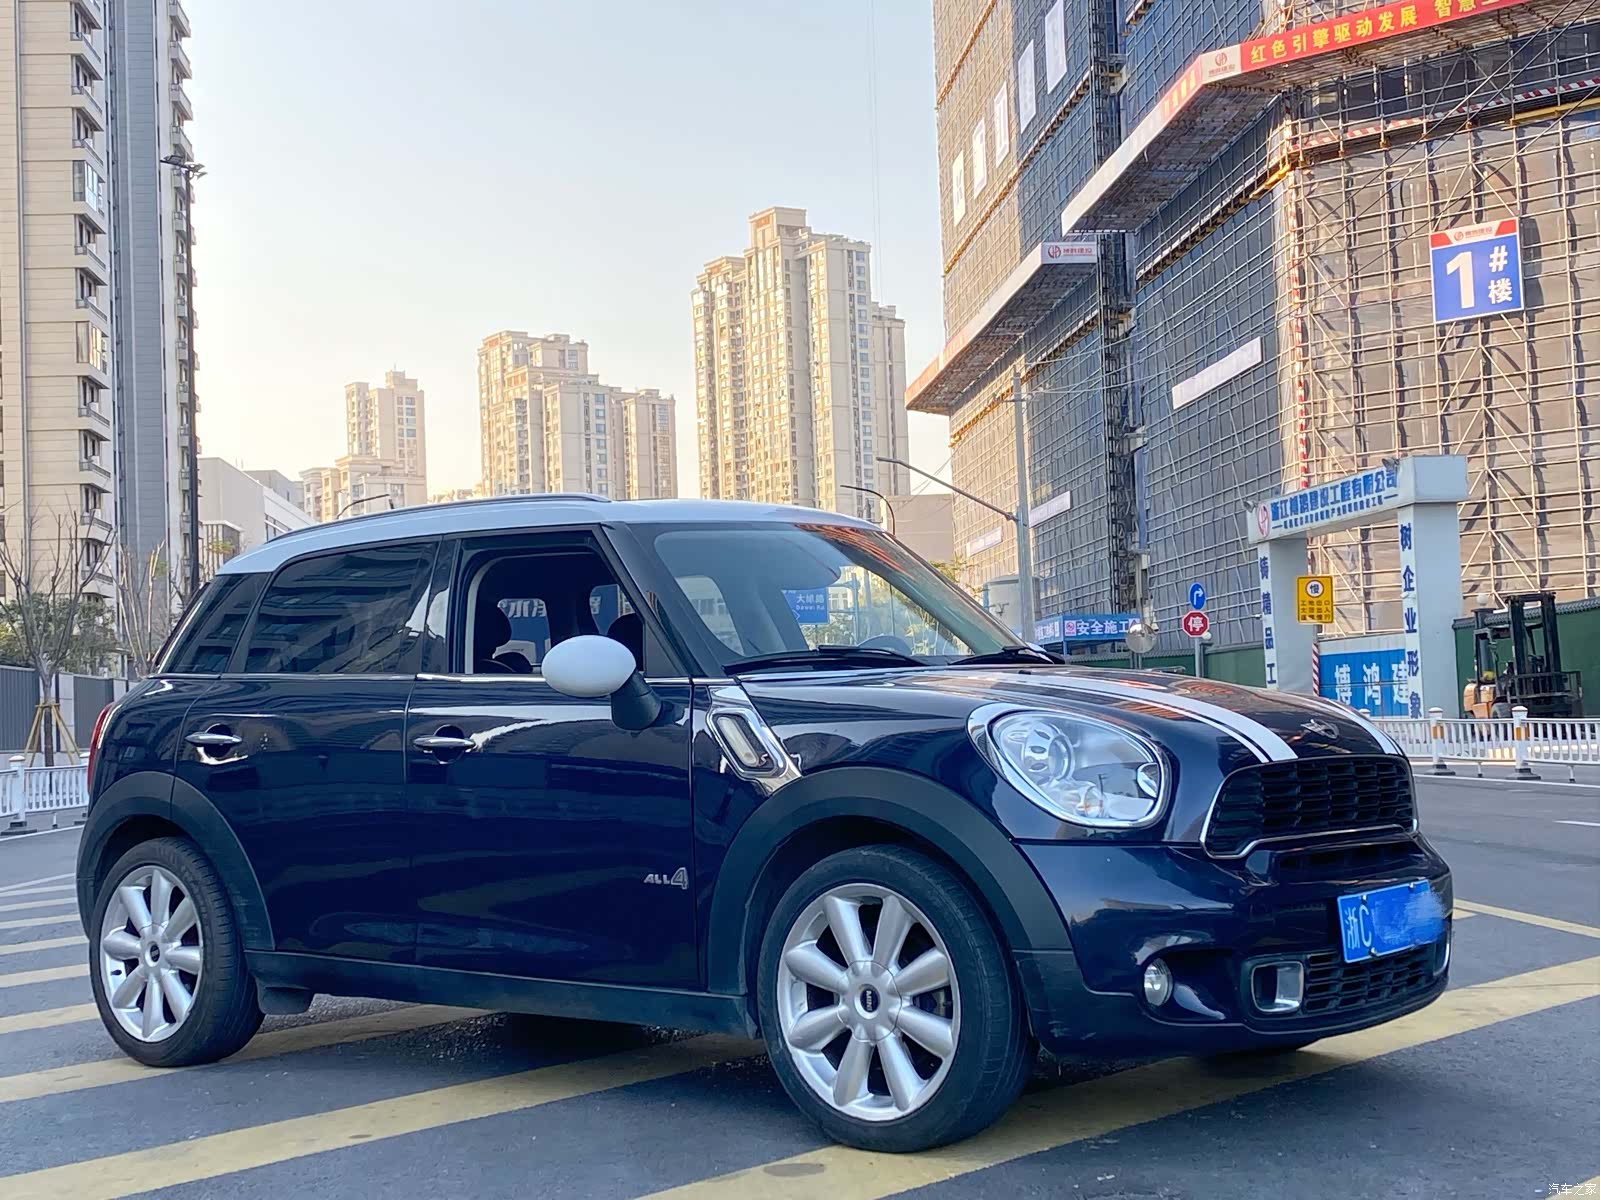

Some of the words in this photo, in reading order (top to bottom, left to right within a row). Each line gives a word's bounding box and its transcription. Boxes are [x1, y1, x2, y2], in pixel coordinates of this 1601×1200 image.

[1250, 7, 1418, 65] 红色引擎驱动发展
[1434, 0, 1500, 17] 智慧
[1446, 250, 1475, 309] 1
[1488, 277, 1513, 305] 楼
[1077, 620, 1129, 636] 安全施工
[1187, 616, 1204, 632] 停
[1400, 522, 1422, 719] 树企业形象
[643, 867, 688, 890] ALL4
